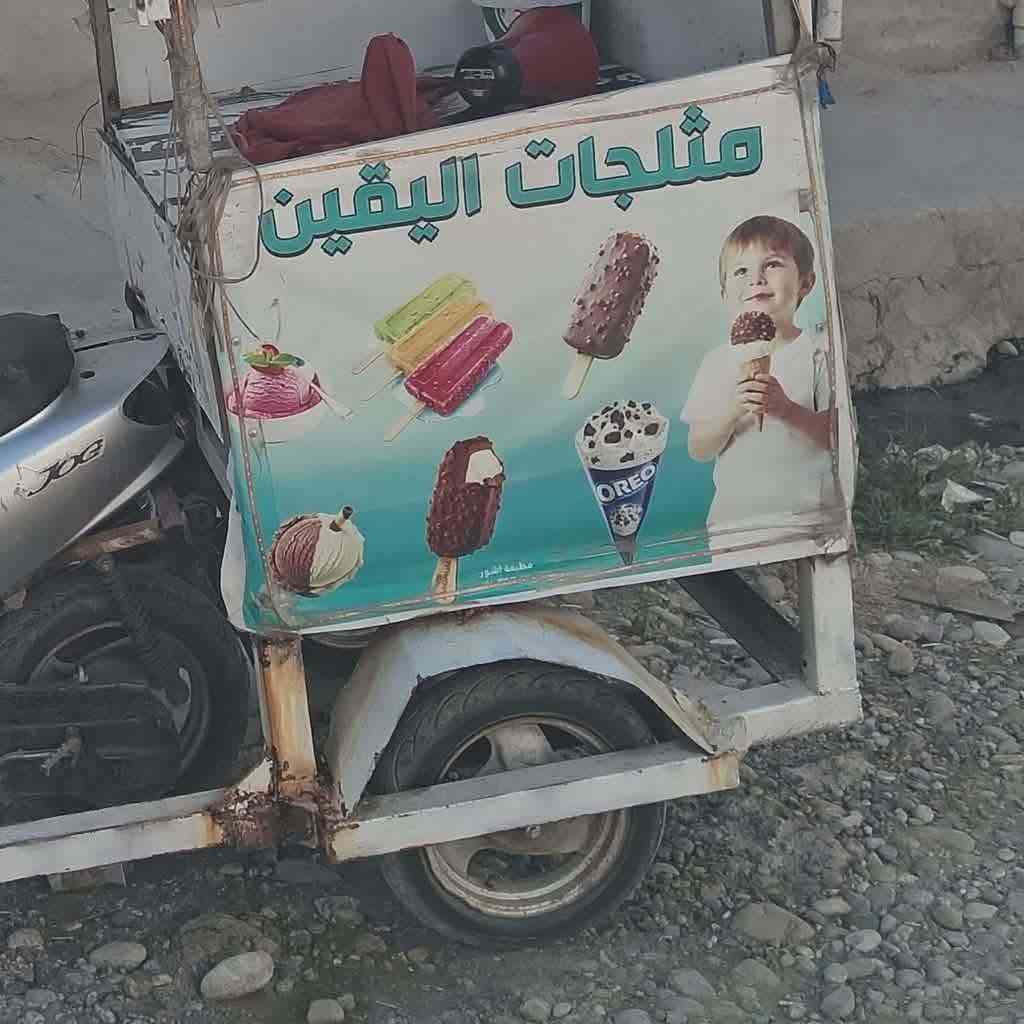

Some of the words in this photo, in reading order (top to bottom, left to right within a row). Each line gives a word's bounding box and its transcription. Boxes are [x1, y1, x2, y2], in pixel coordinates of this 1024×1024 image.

[504, 103, 763, 211] مثلجات
[258, 153, 480, 258] اليقين
[27, 438, 104, 497] JOG
[596, 462, 657, 503] OREO
